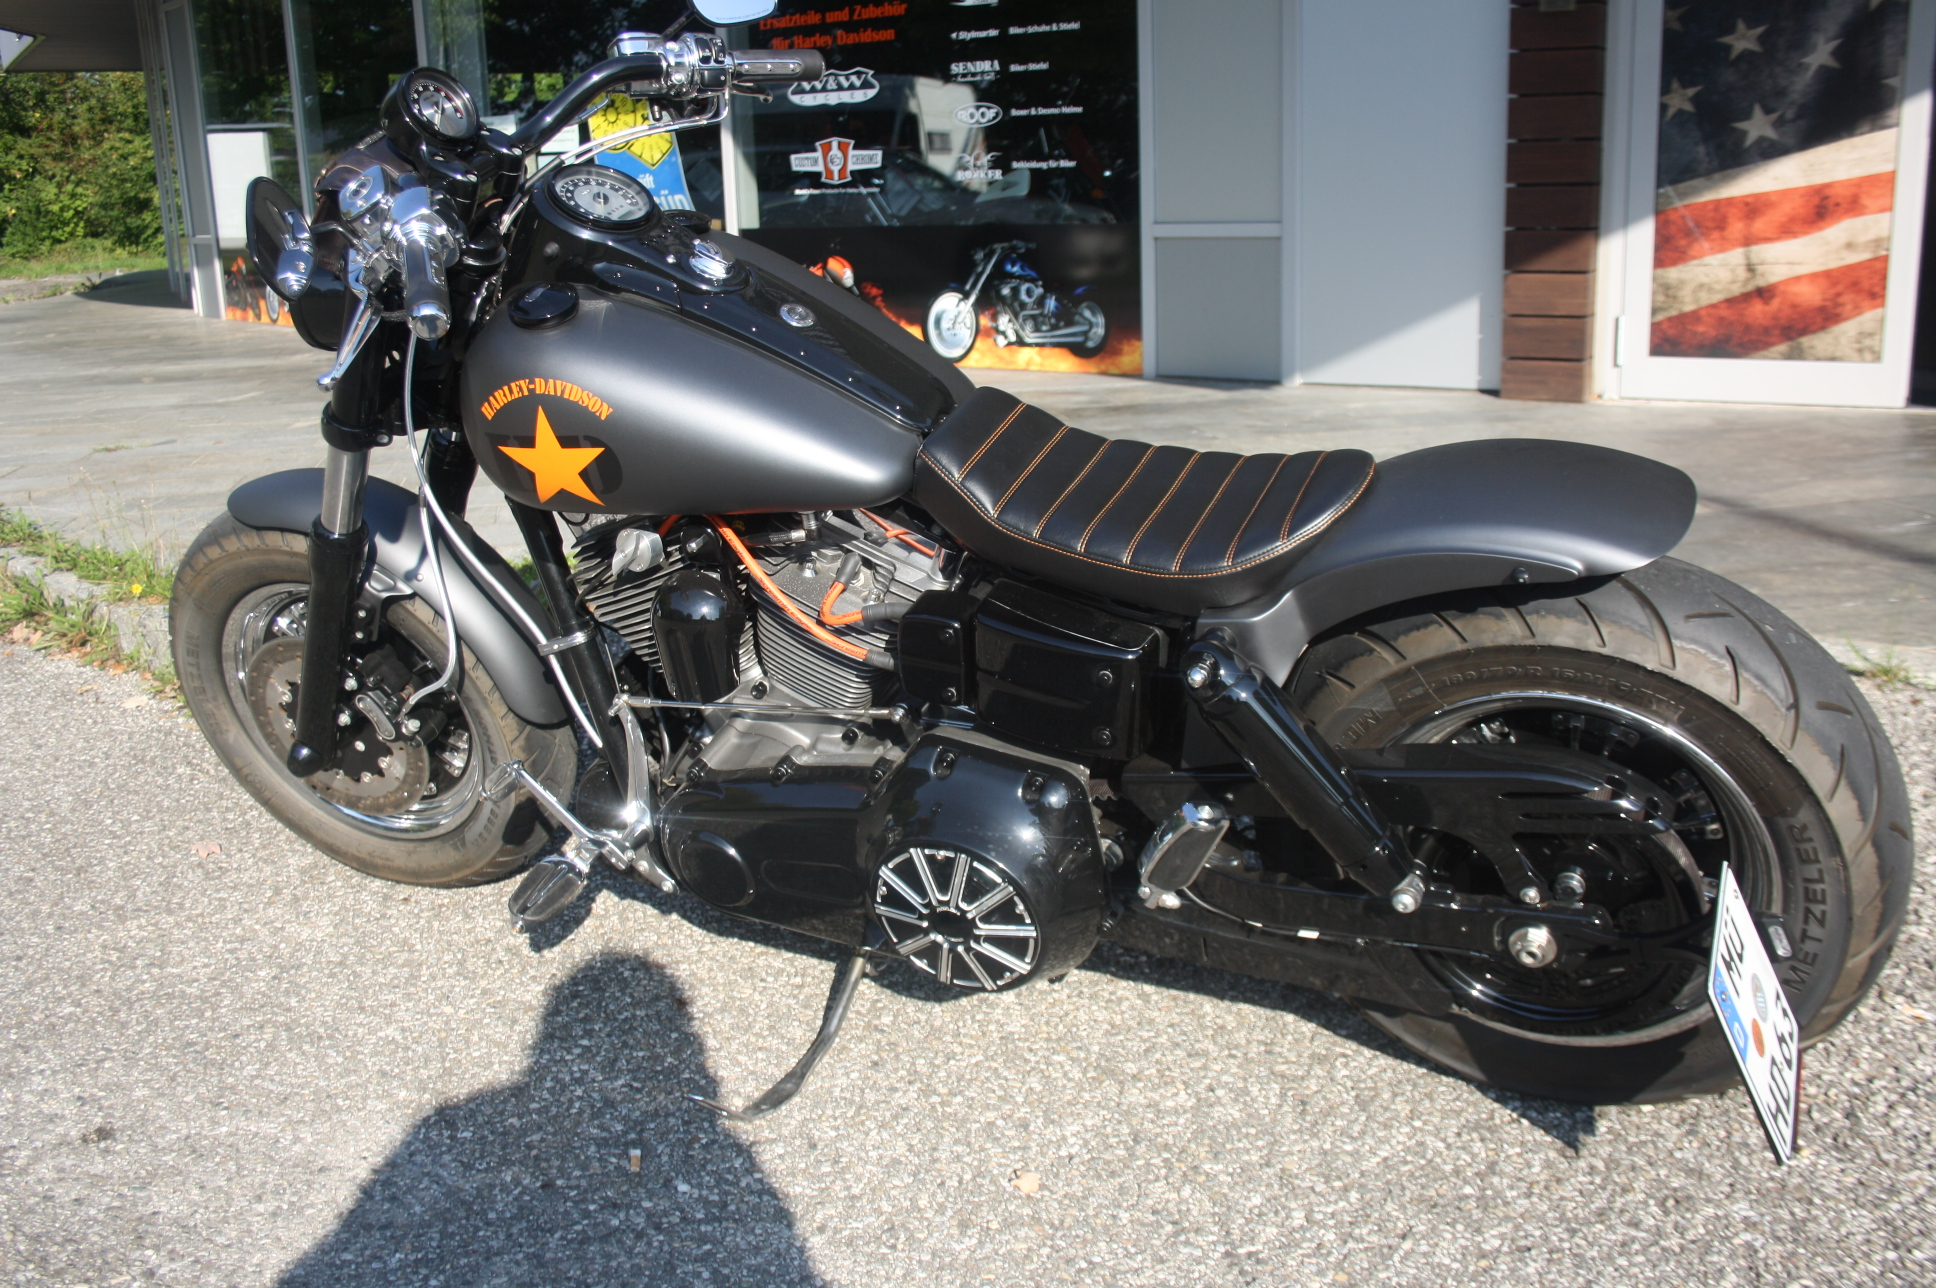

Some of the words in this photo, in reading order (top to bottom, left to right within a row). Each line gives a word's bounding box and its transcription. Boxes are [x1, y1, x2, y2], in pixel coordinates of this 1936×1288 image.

[760, 10, 822, 30] Ersatzteile
[826, 6, 850, 23] und
[853, 1, 908, 20] Zubehör
[772, 36, 790, 49] für
[794, 32, 834, 49] Harley
[837, 27, 895, 45] Davidson
[950, 59, 1000, 75] SENDRA
[800, 91, 868, 103] CYCLES
[957, 107, 998, 124] ROOF
[794, 155, 820, 168] CUSTOM
[851, 153, 880, 165] CHROME
[1049, 159, 1059, 168] für
[1060, 159, 1077, 167] Biker
[481, 377, 614, 420] HARLEY-DAVIDSON
[1782, 823, 1828, 993] METZELER
[1720, 904, 1745, 999] MÜ
[1765, 1053, 1792, 1149] HD
